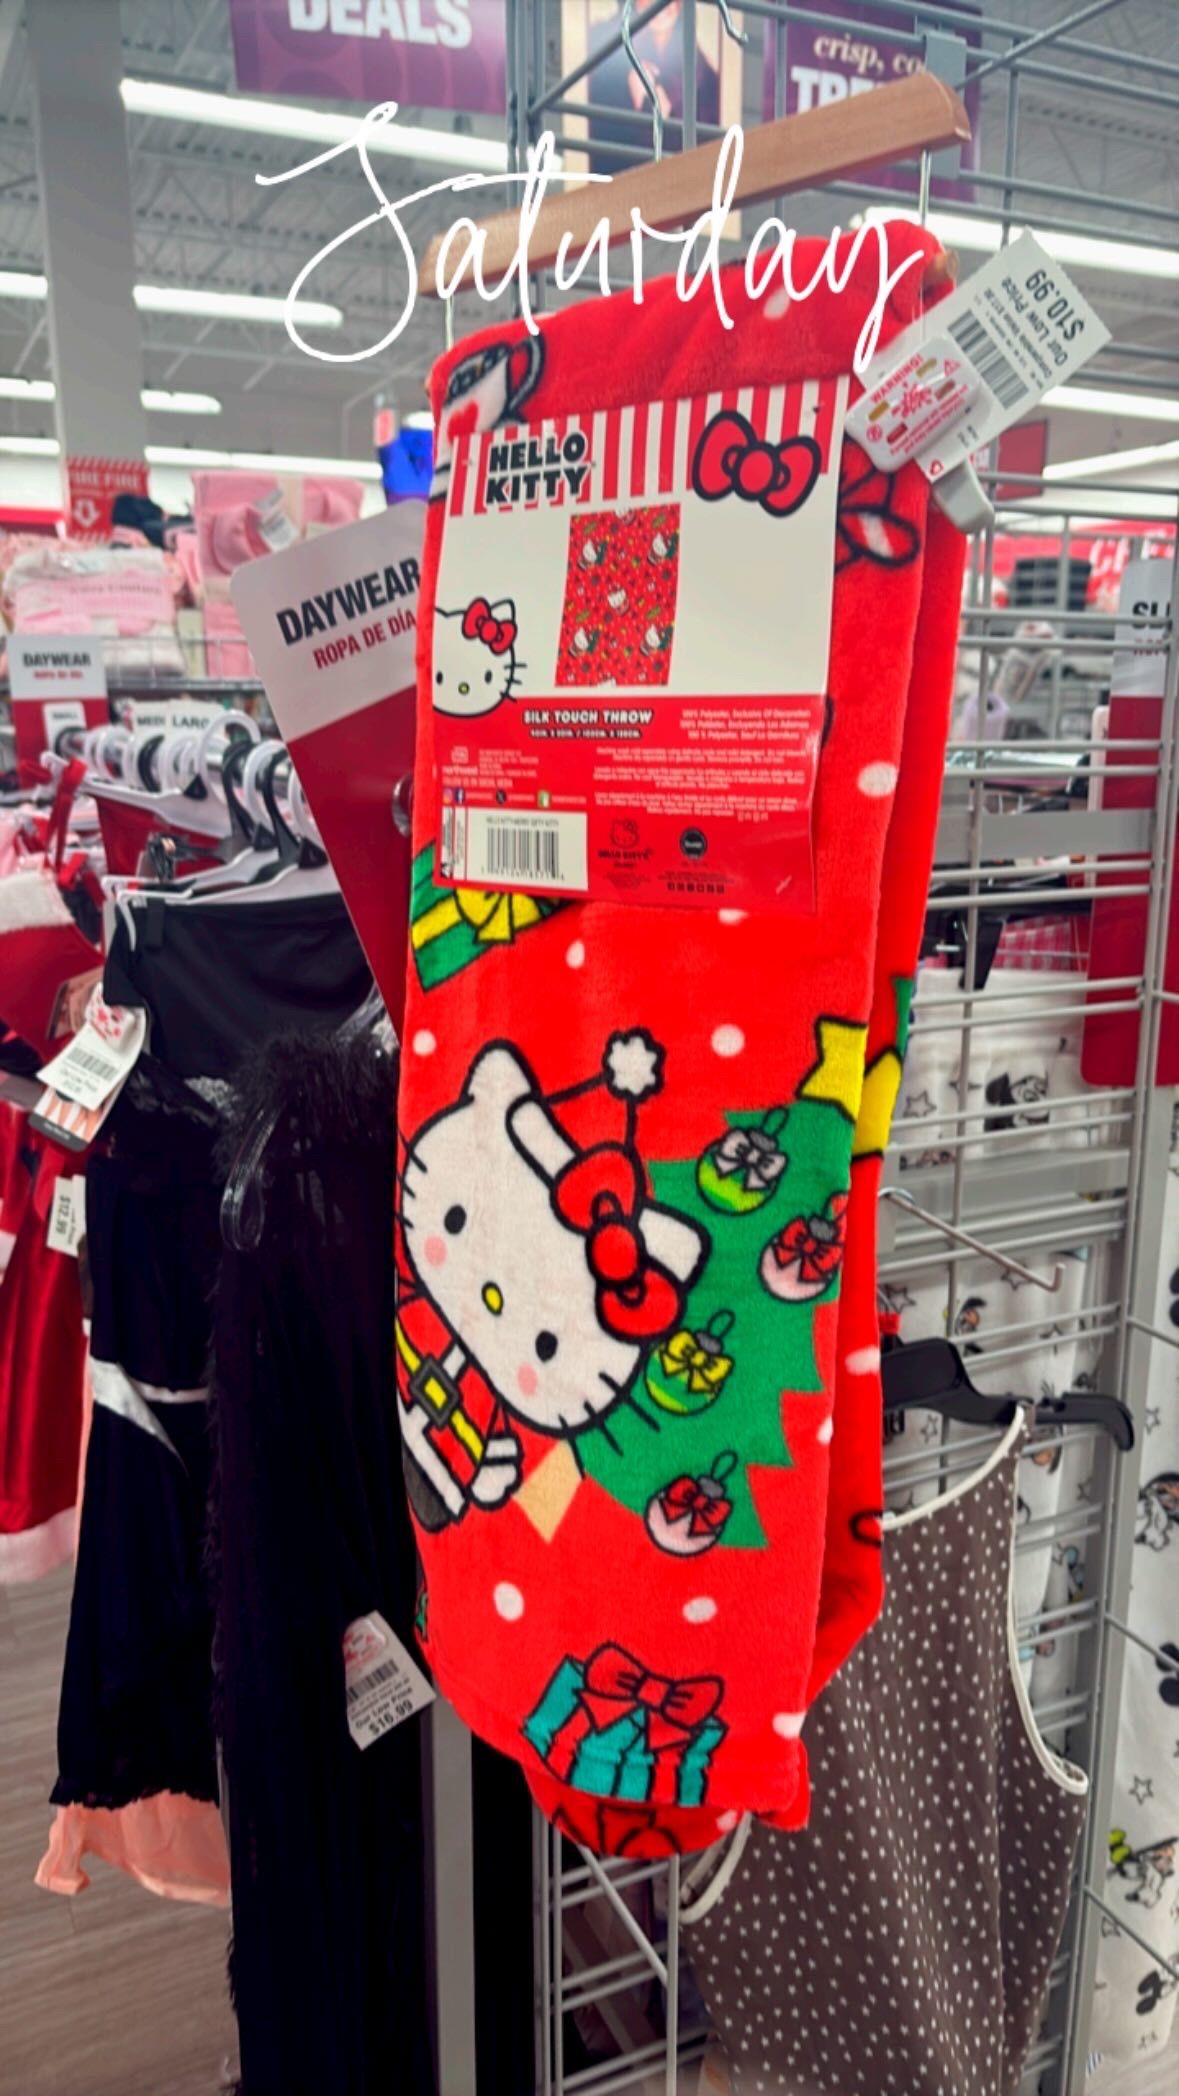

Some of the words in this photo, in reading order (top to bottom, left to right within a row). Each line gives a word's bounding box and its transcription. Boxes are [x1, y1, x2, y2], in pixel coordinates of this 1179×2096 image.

[288, 0, 472, 49] DEALS
[813, 33, 884, 74] crisp,
[1001, 276, 1029, 314] Price
[1025, 269, 1084, 341] $10.99
[1027, 310, 1050, 342] Low
[1047, 340, 1068, 367] Our
[871, 353, 924, 403] WARNING!
[490, 433, 586, 472] HELLO
[486, 466, 589, 504] KITTY
[276, 557, 421, 647] DAYWEAR
[313, 634, 361, 670] ROPA
[362, 622, 386, 648] DE
[387, 607, 416, 637] DÍA
[23, 652, 91, 667] DAYWEAR
[524, 709, 550, 724] SILK
[554, 709, 599, 724] TOUCH
[603, 709, 653, 724] THROW
[369, 1699, 413, 1735] $16.99
